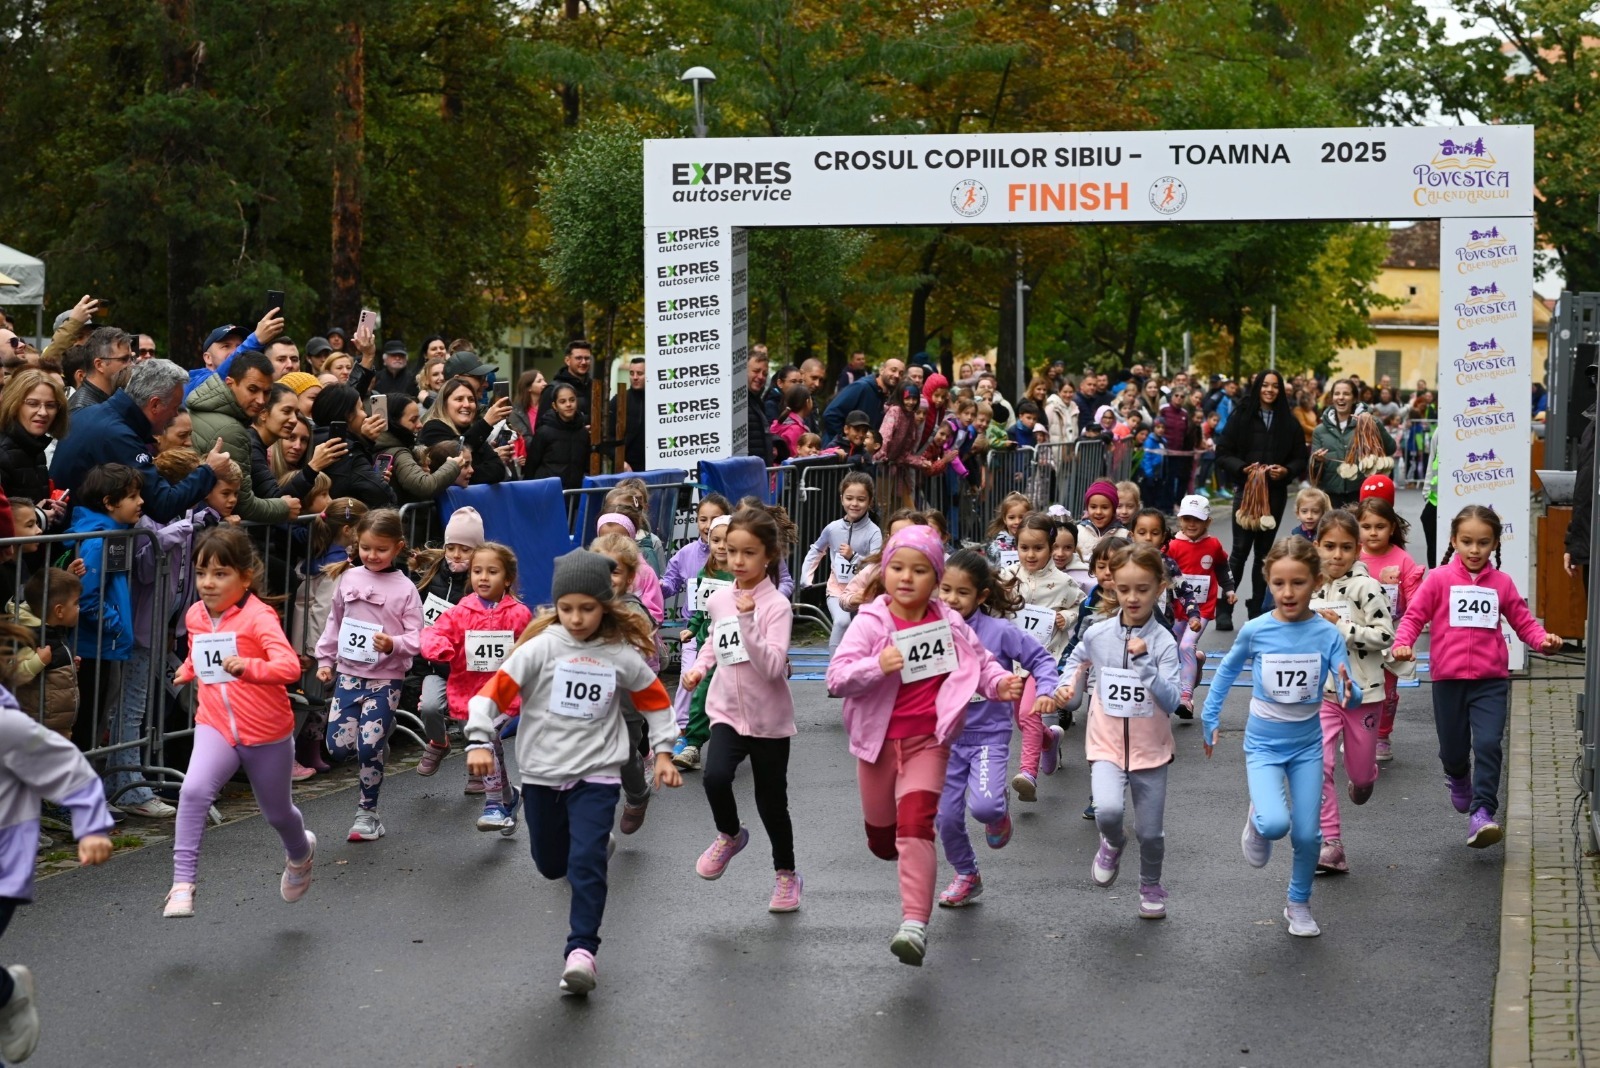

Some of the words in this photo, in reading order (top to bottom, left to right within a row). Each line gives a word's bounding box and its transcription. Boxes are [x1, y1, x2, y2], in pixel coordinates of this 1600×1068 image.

[813, 149, 918, 171] CROSUL
[924, 147, 1047, 170] COPIILOR
[1054, 145, 1122, 168] SIBIU
[1169, 143, 1291, 165] TOAMNA
[1320, 141, 1387, 163] 2025
[672, 161, 792, 186] EXPRES
[672, 185, 792, 203] autoservice
[1008, 182, 1128, 212] FINISH
[657, 226, 719, 244] EXPRES
[659, 238, 720, 252] autoservice
[657, 260, 719, 278] EXPRES
[659, 273, 720, 287] autoservice
[657, 295, 719, 312] EXPRES
[659, 308, 720, 322] autoservice
[657, 329, 719, 347] EXPRES
[659, 342, 720, 356] autoservice
[657, 364, 719, 381] EXPRES
[659, 376, 720, 390] autoservice
[658, 398, 720, 415] EXPRES
[659, 411, 720, 424] autoservice
[658, 432, 720, 450] EXPRES
[659, 445, 720, 458] autoservice
[1458, 598, 1491, 614] 240
[1024, 616, 1040, 630] 17
[348, 632, 366, 648] 32
[718, 631, 740, 649] 44
[474, 644, 504, 658] 415
[908, 638, 946, 662] 424
[204, 650, 223, 668] 14
[1276, 670, 1307, 687] 172
[566, 681, 602, 702] 108
[1108, 684, 1145, 702] 255
